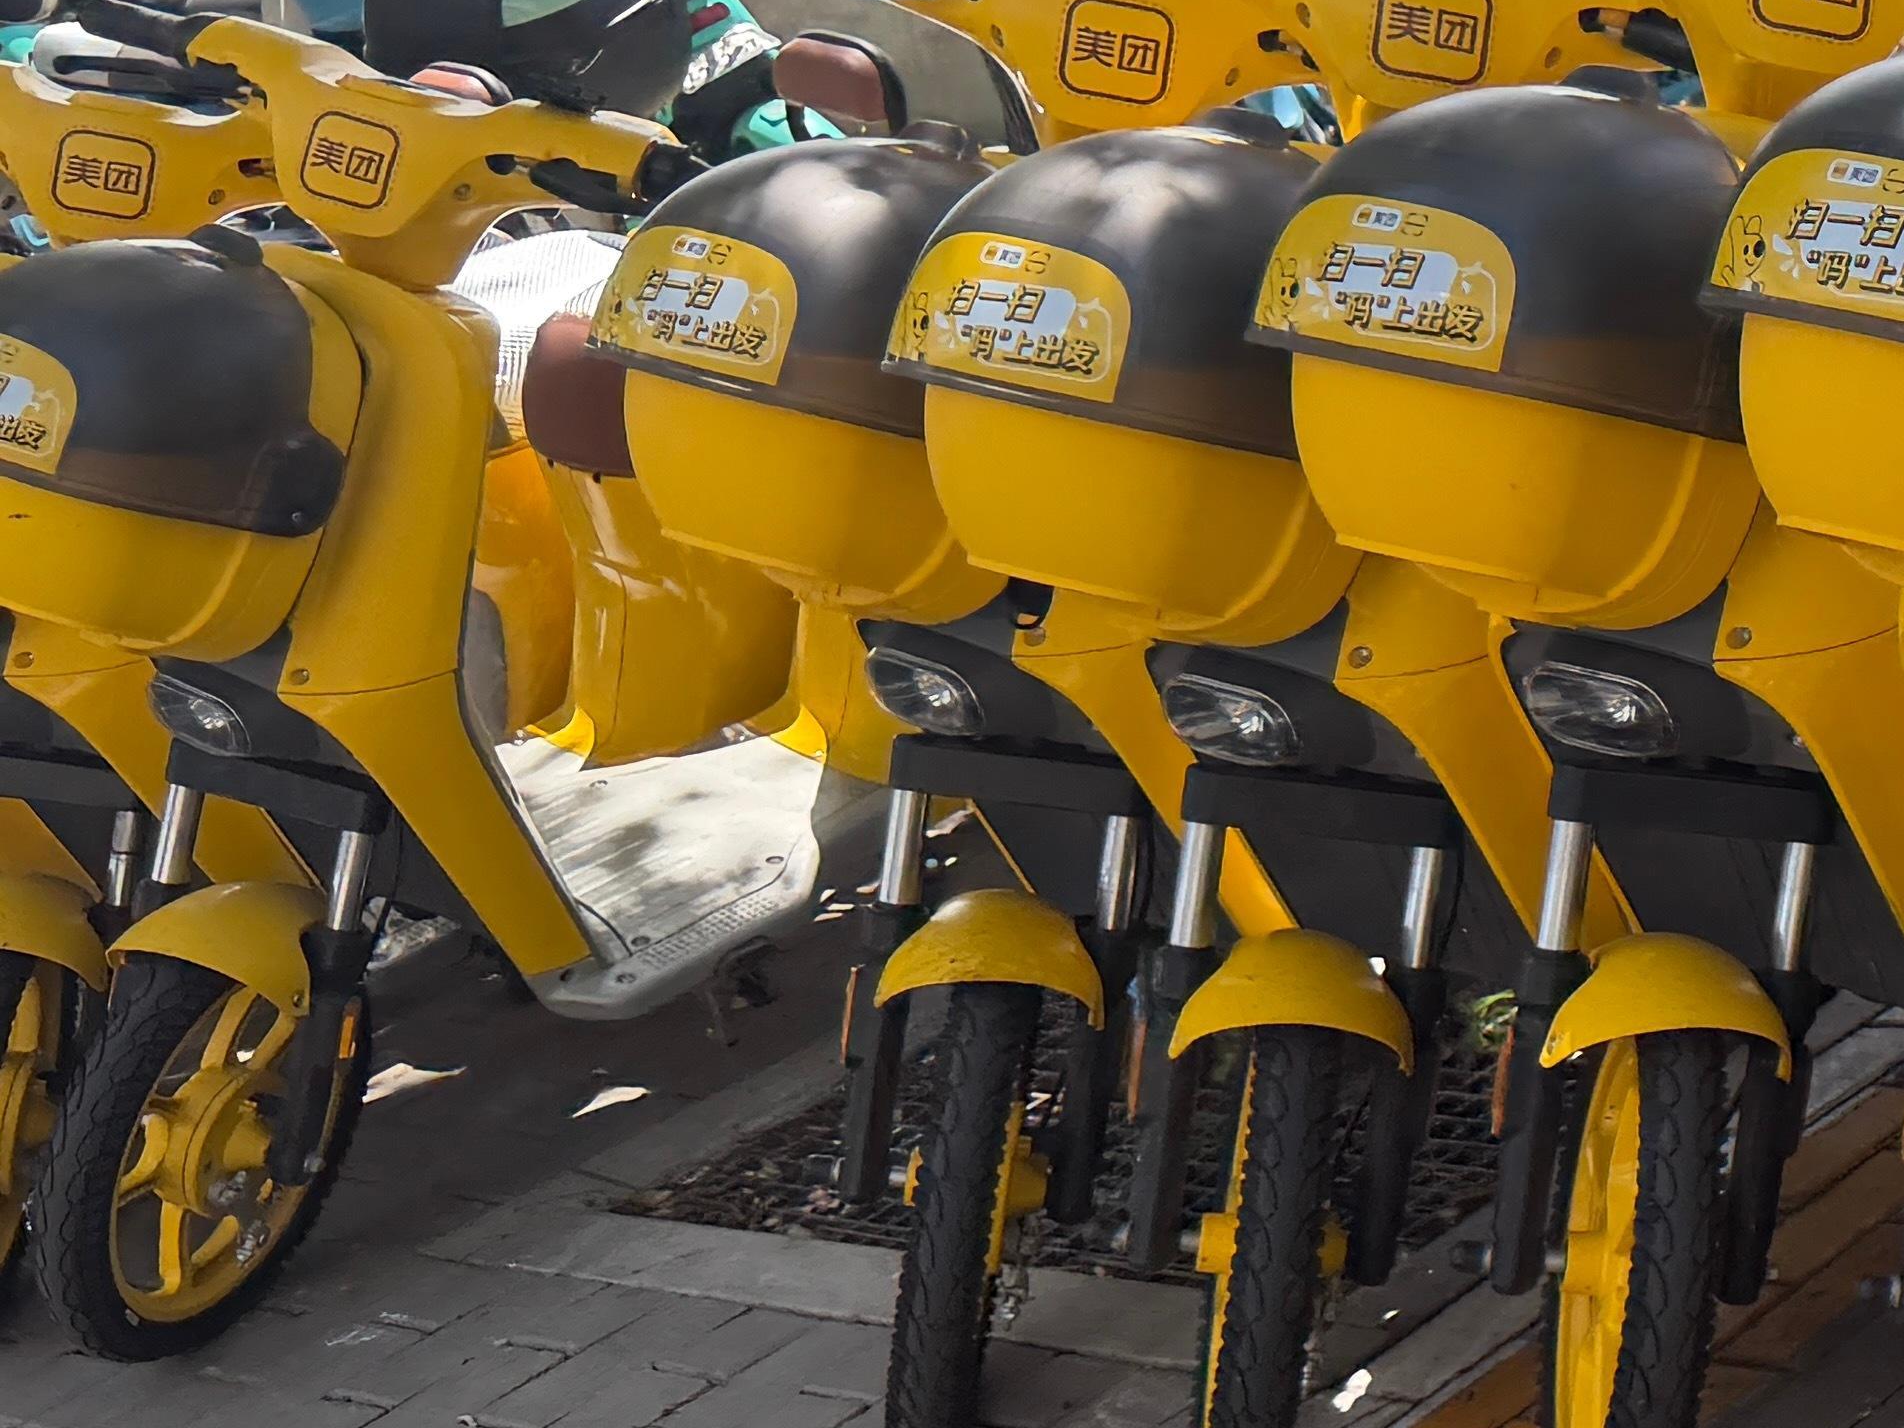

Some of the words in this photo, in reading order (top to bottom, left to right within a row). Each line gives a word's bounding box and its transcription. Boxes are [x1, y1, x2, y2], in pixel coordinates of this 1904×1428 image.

[1071, 26, 1161, 75] 美团
[1386, 1, 1479, 55] 美团
[63, 154, 142, 196] 美团
[310, 136, 385, 185] 美团
